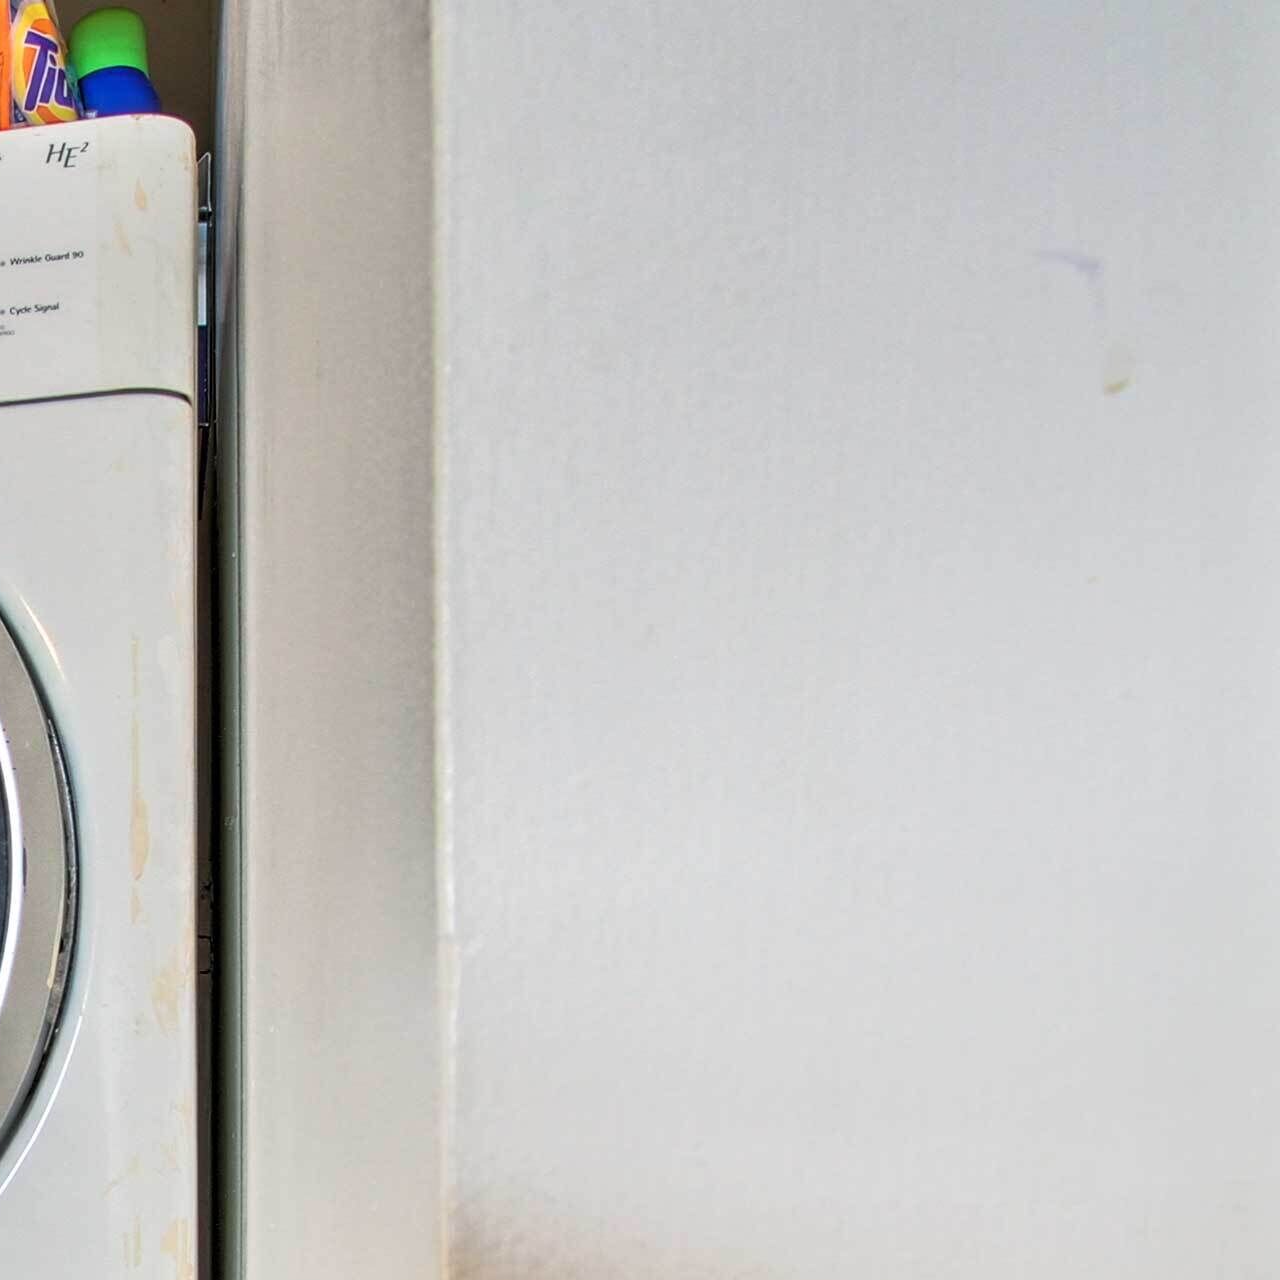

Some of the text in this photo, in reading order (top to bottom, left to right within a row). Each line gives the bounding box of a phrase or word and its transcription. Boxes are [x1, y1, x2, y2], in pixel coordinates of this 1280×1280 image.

[9, 250, 84, 266] Wrinkle Guard 90
[9, 303, 60, 316] Cycle Signal
